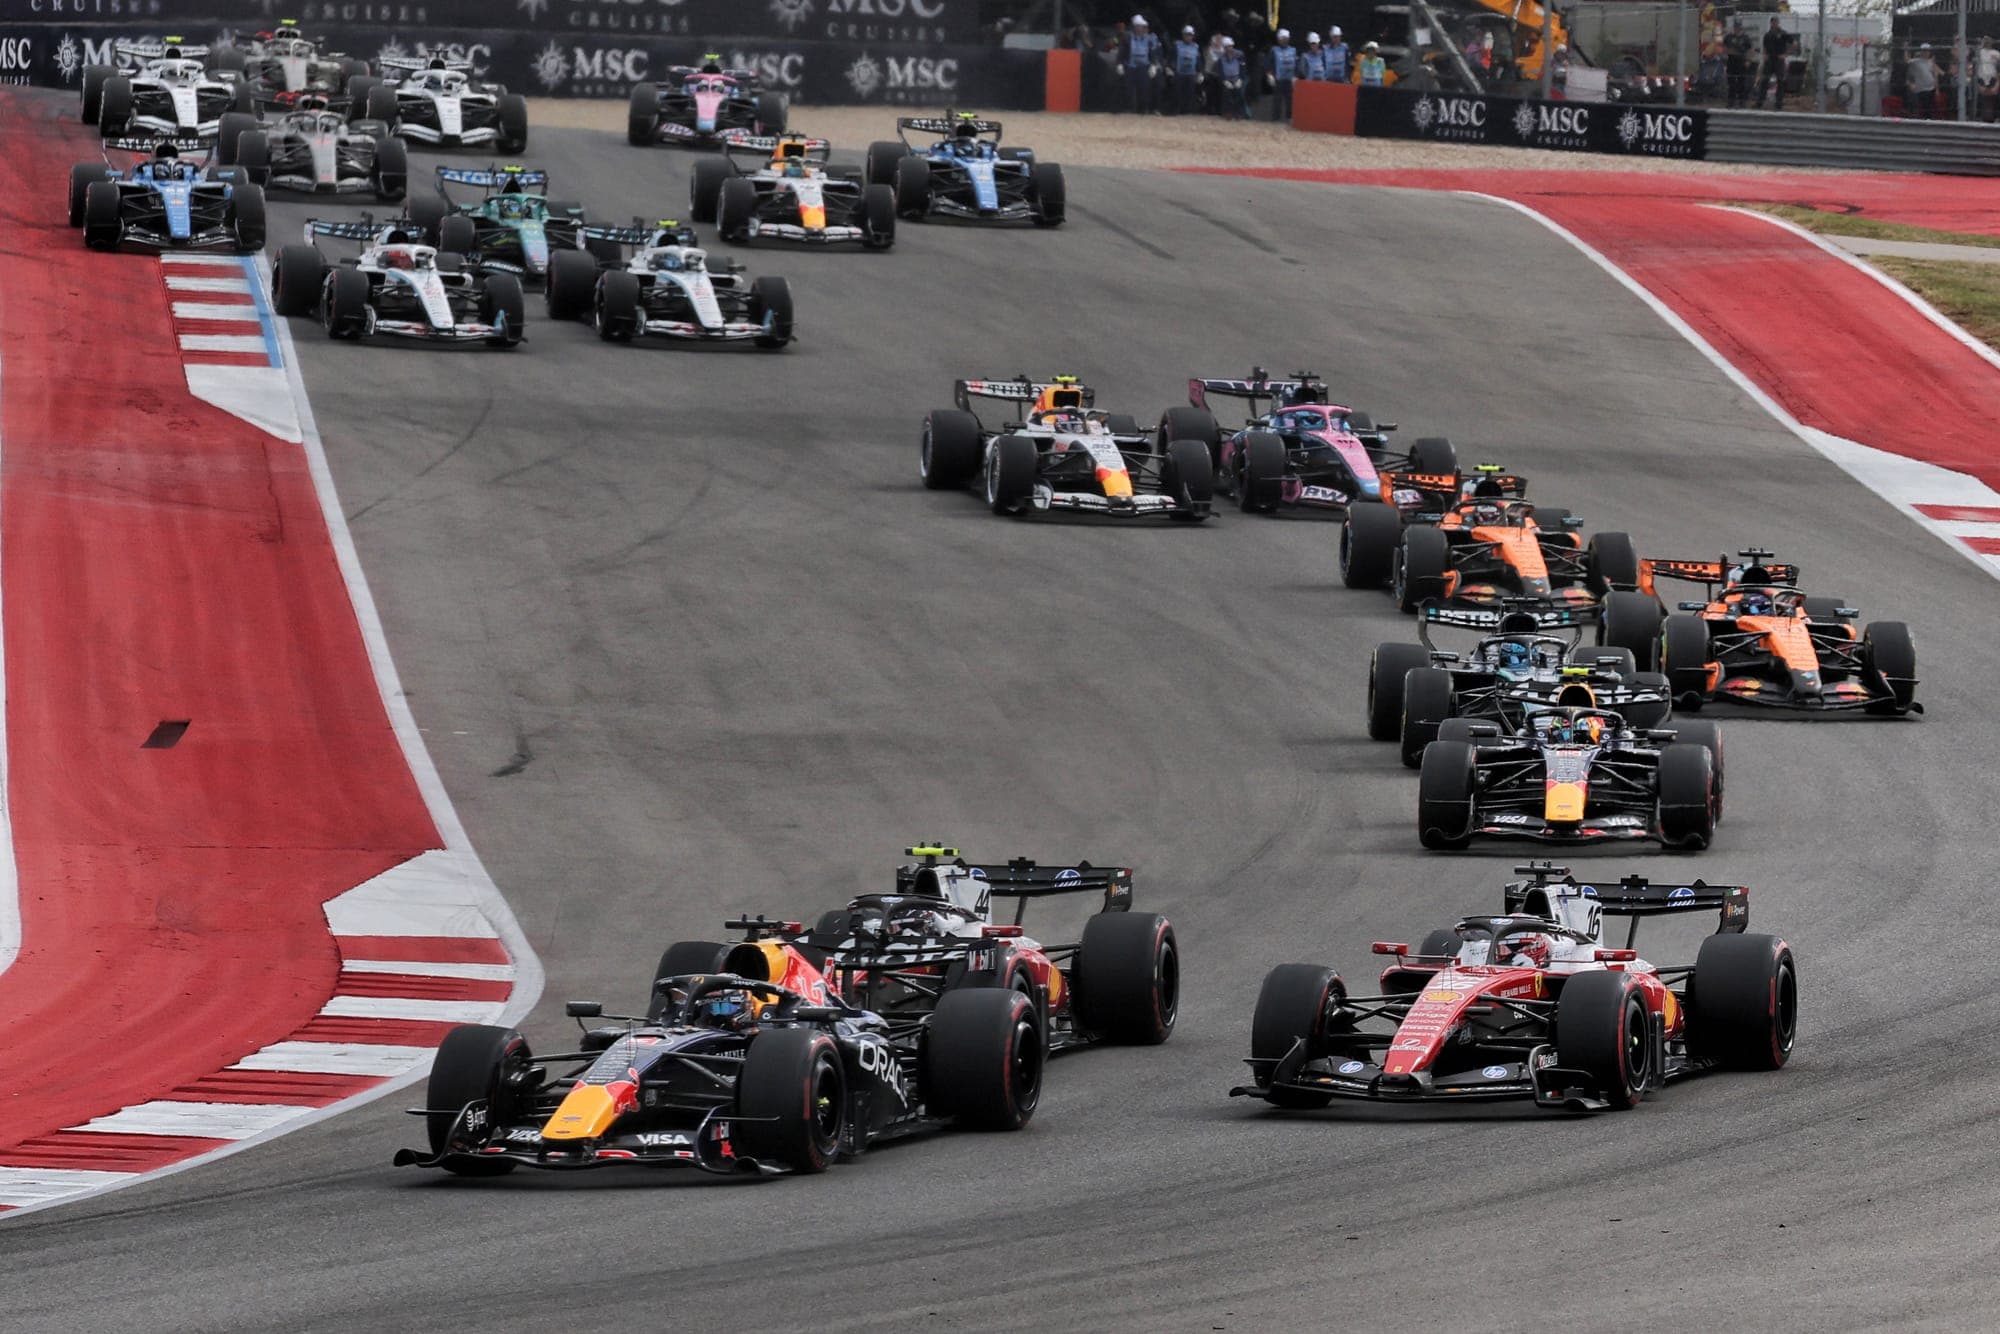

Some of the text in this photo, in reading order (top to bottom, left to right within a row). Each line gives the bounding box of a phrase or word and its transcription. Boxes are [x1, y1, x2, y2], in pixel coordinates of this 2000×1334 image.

[572, 47, 649, 82] MSC
[886, 56, 958, 90] MSC
[1437, 98, 1486, 126] MSC
[1538, 105, 1588, 134] MSC
[1643, 113, 1692, 141] MSC
[1440, 609, 1559, 627] PETRAS
[1493, 815, 1529, 824] VISA
[974, 888, 991, 914] 44
[1585, 904, 1602, 942] 16
[636, 1134, 690, 1145] VISA
